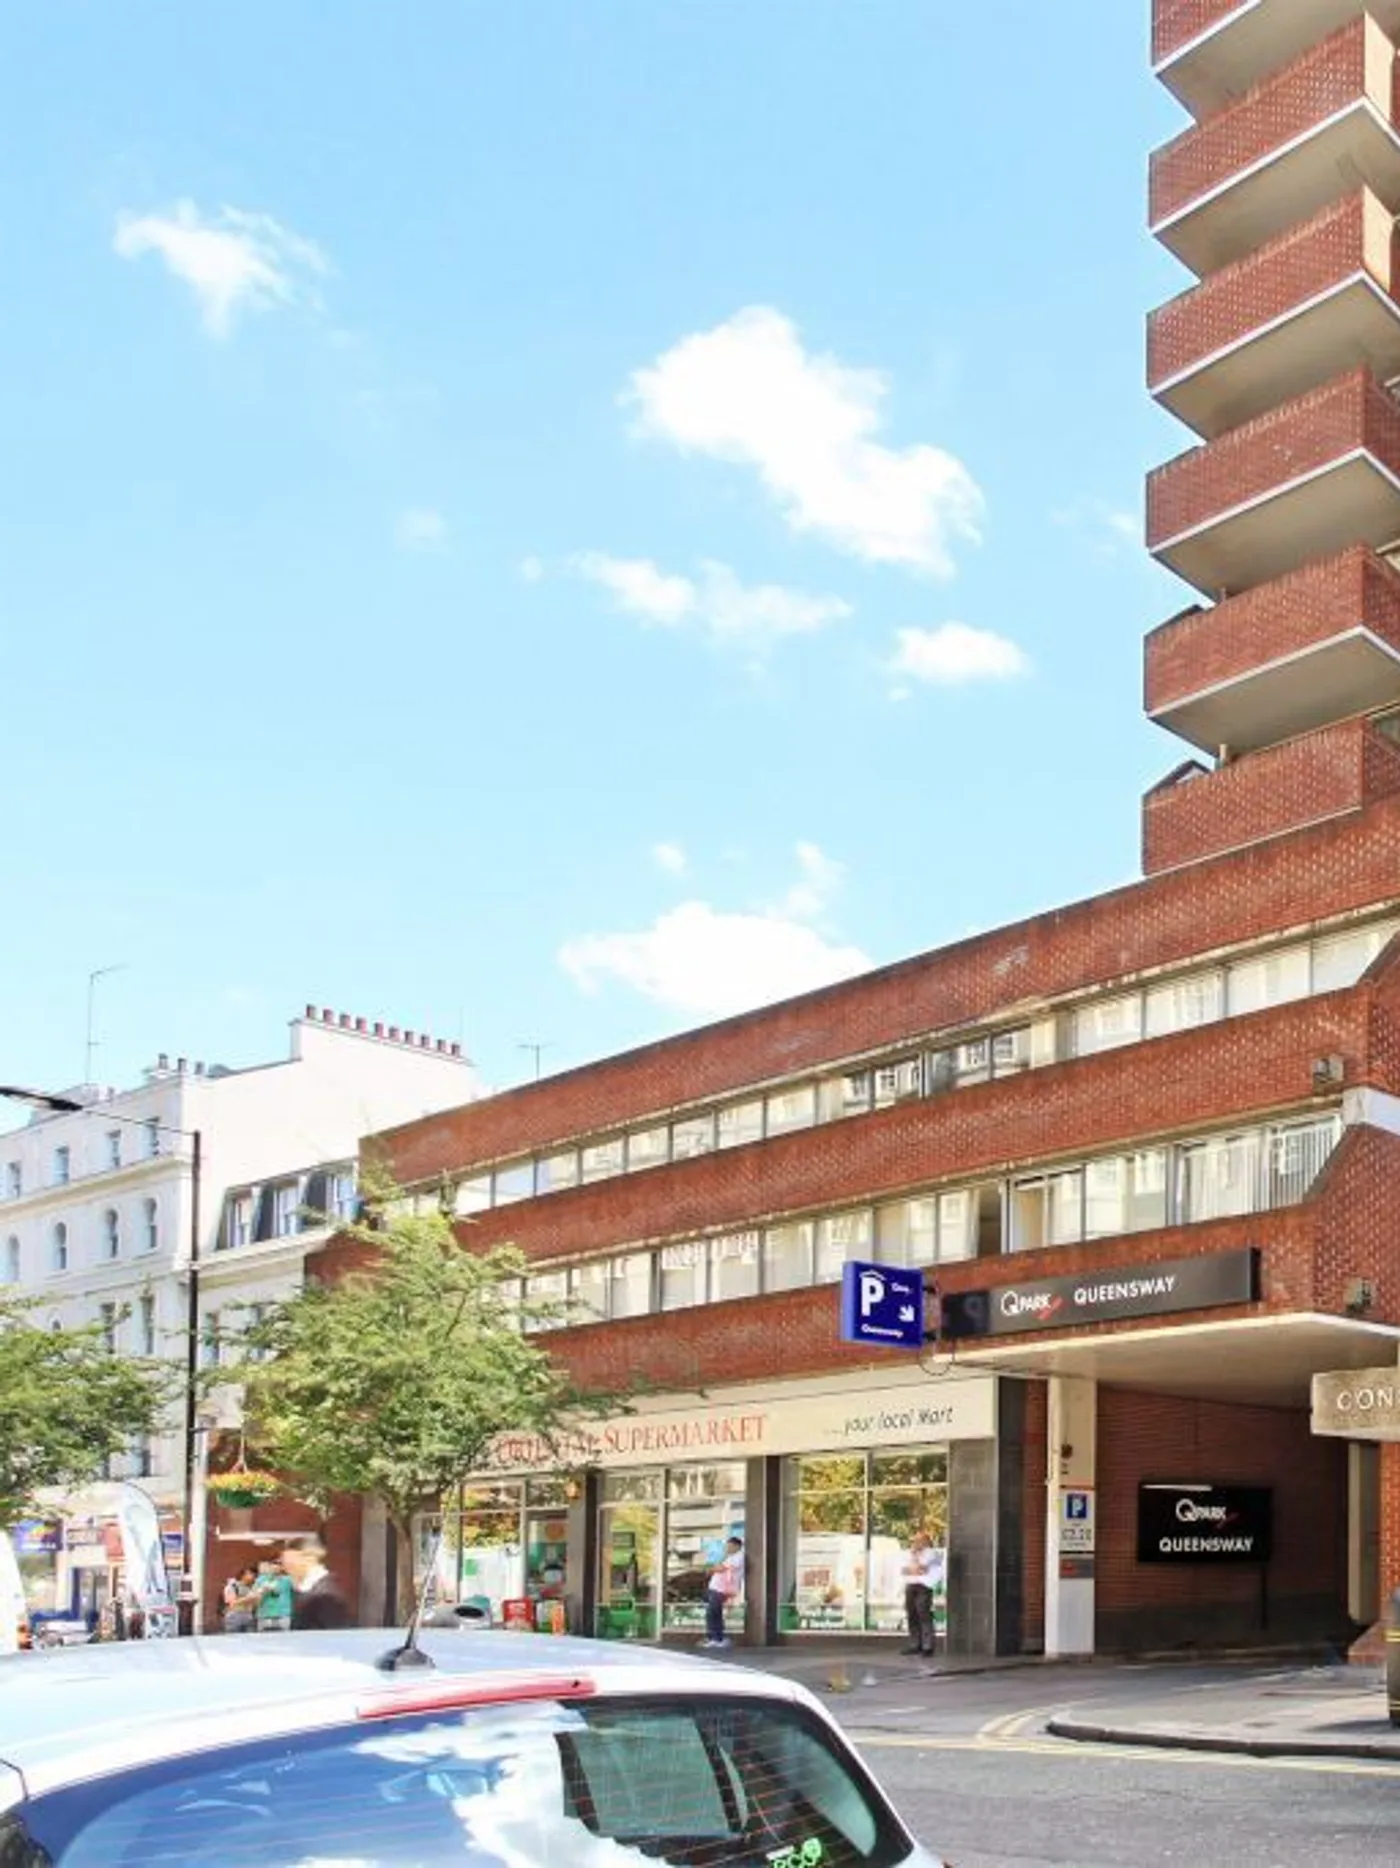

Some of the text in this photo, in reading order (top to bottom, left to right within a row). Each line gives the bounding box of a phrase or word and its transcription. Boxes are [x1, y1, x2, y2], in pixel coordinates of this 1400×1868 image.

[861, 1277, 885, 1317] P
[1074, 1275, 1176, 1305] QUEENSWAY
[603, 1415, 767, 1453] SUPERMARKET
[1159, 1536, 1253, 1553] QUEENSWAY
